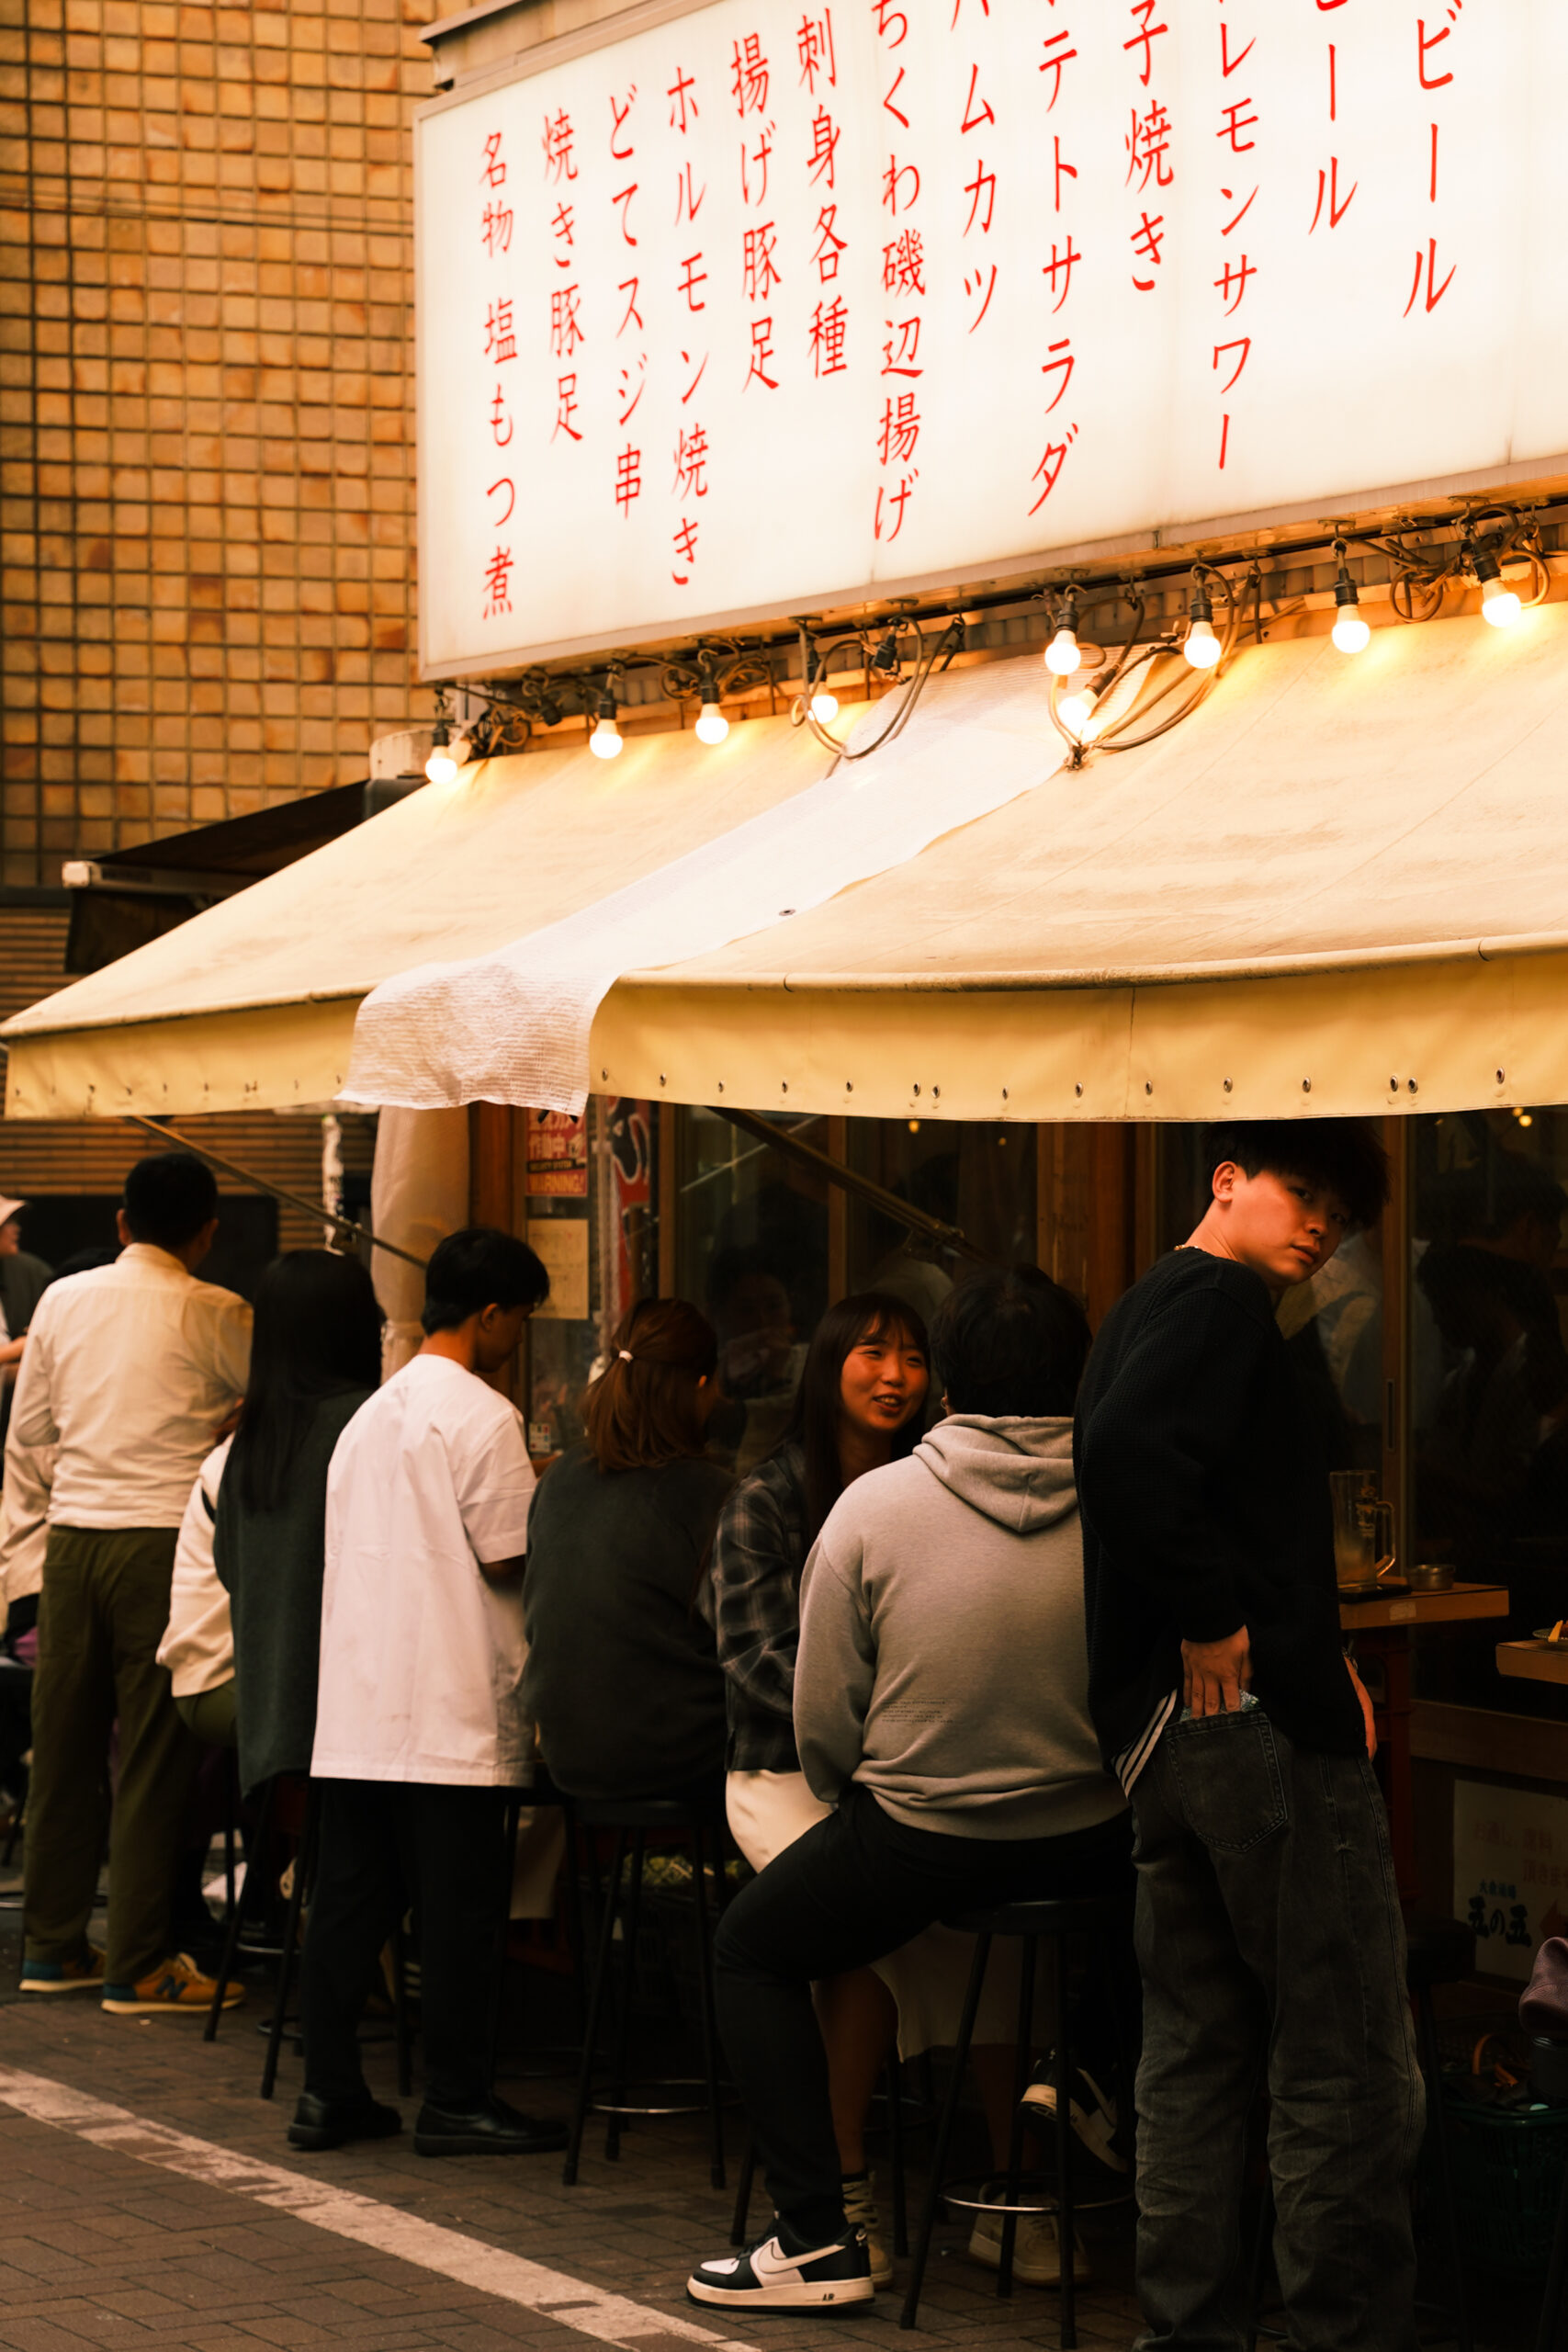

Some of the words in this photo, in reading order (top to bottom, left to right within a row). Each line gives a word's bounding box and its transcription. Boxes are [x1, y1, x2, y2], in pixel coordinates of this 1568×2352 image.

[479, 130, 515, 259] 名物
[541, 107, 585, 445] 焼き豚足
[730, 32, 782, 394] 揚げ豚足
[795, 6, 849, 379] 刺身各種
[871, 0, 926, 543] ちくわ磯辺揚げ
[1027, 0, 1082, 517] テトサラダ
[1213, 0, 1259, 470] レモンサワー
[1309, 0, 1359, 236] ール
[1403, 0, 1463, 318] ビール
[482, 297, 518, 620] 塩もつ煮
[609, 84, 647, 519] どてスジ串
[667, 66, 708, 586] ホルモン焼き
[823, 2293, 834, 2301] AIR
